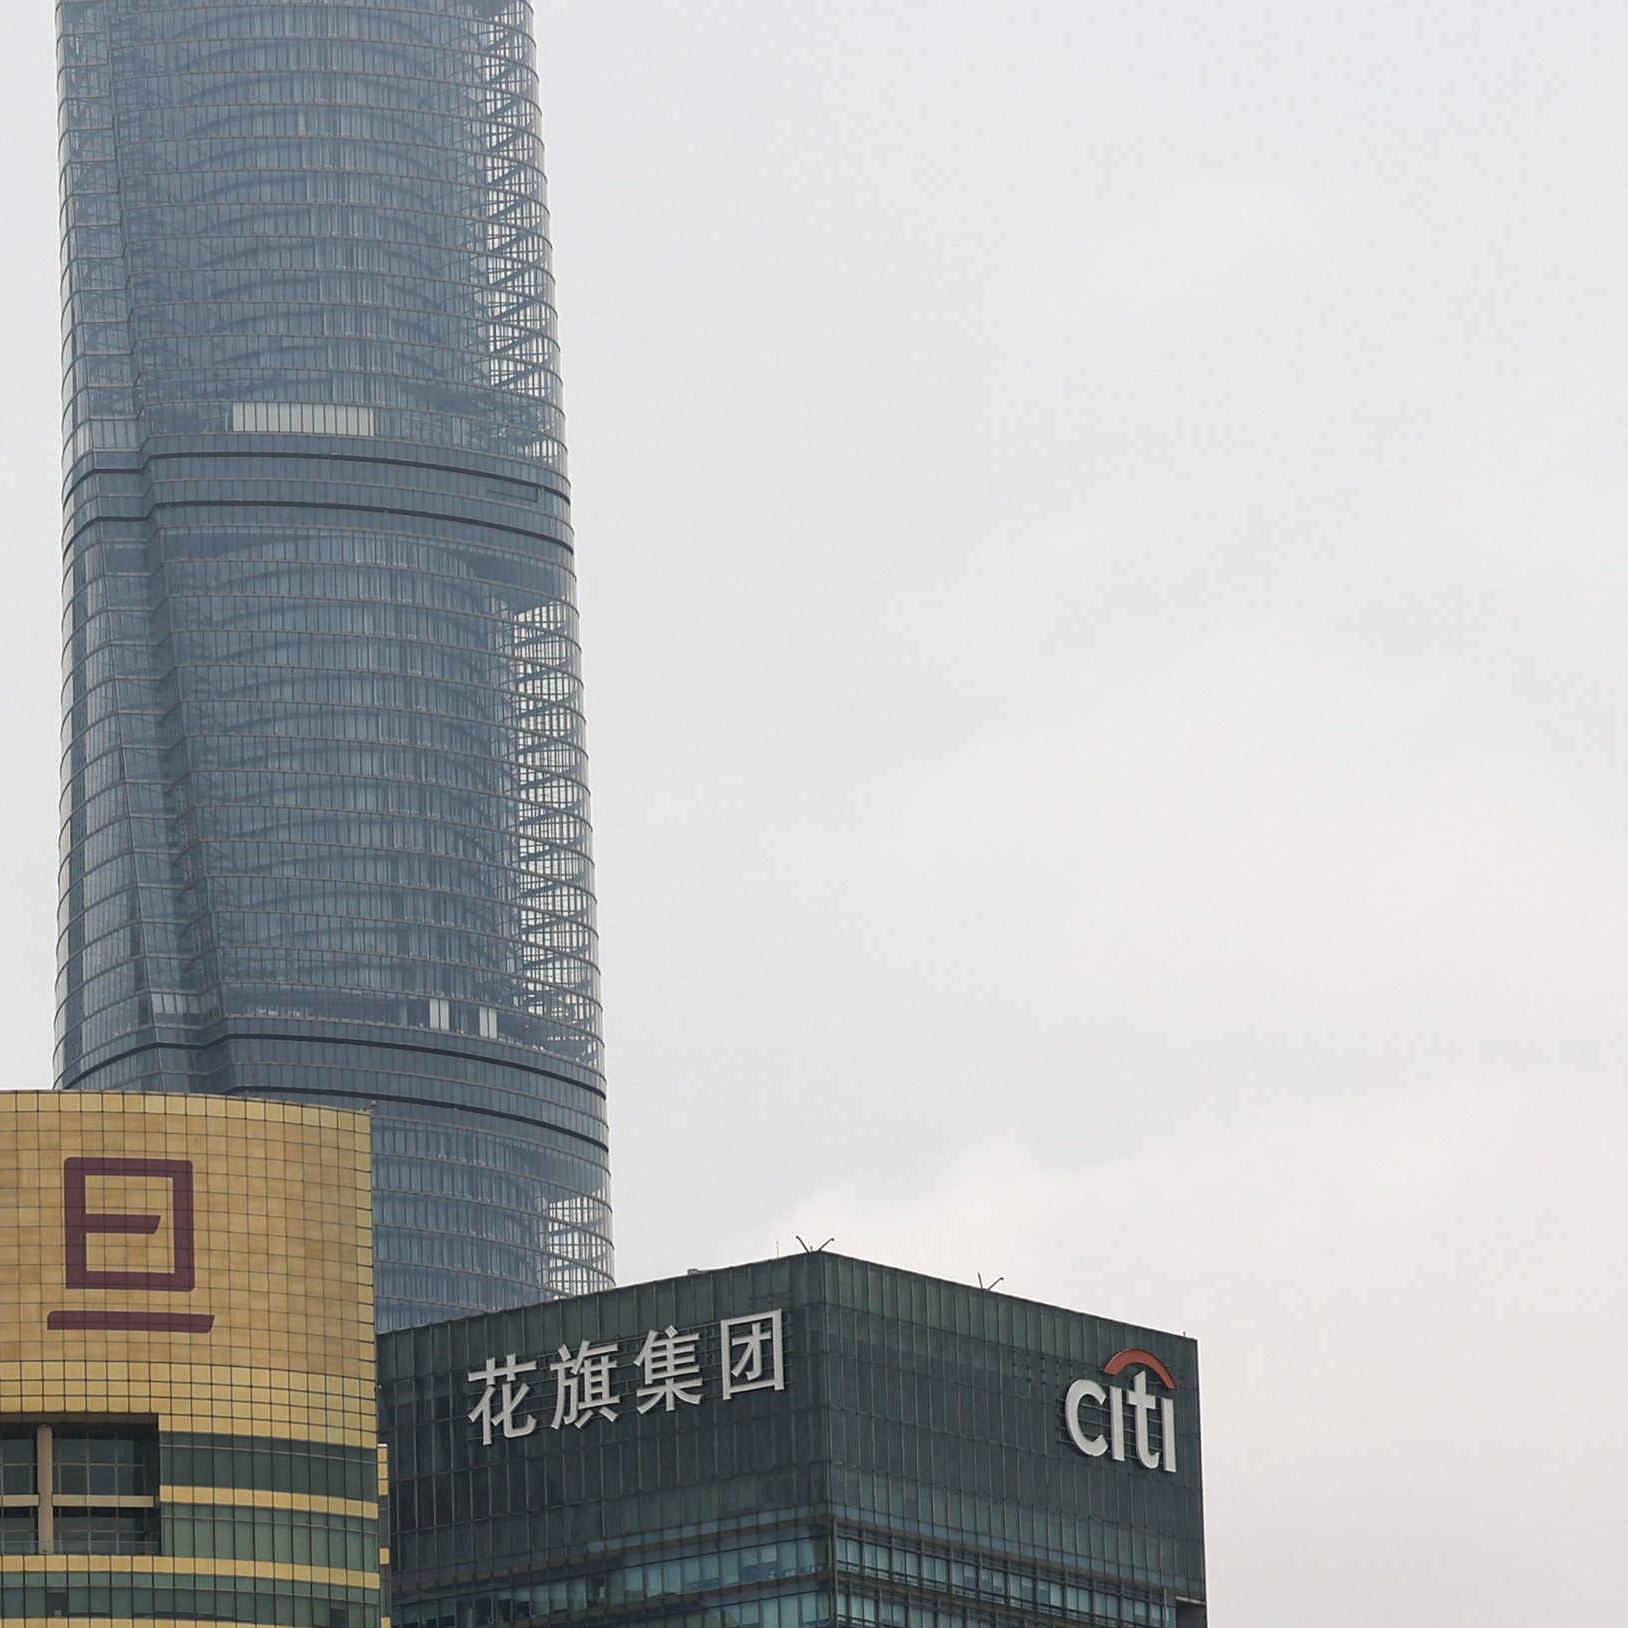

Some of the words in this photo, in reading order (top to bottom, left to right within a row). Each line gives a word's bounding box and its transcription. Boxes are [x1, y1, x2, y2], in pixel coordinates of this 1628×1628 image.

[467, 1308, 785, 1445] 花旗集团
[1065, 1369, 1177, 1473] citi
